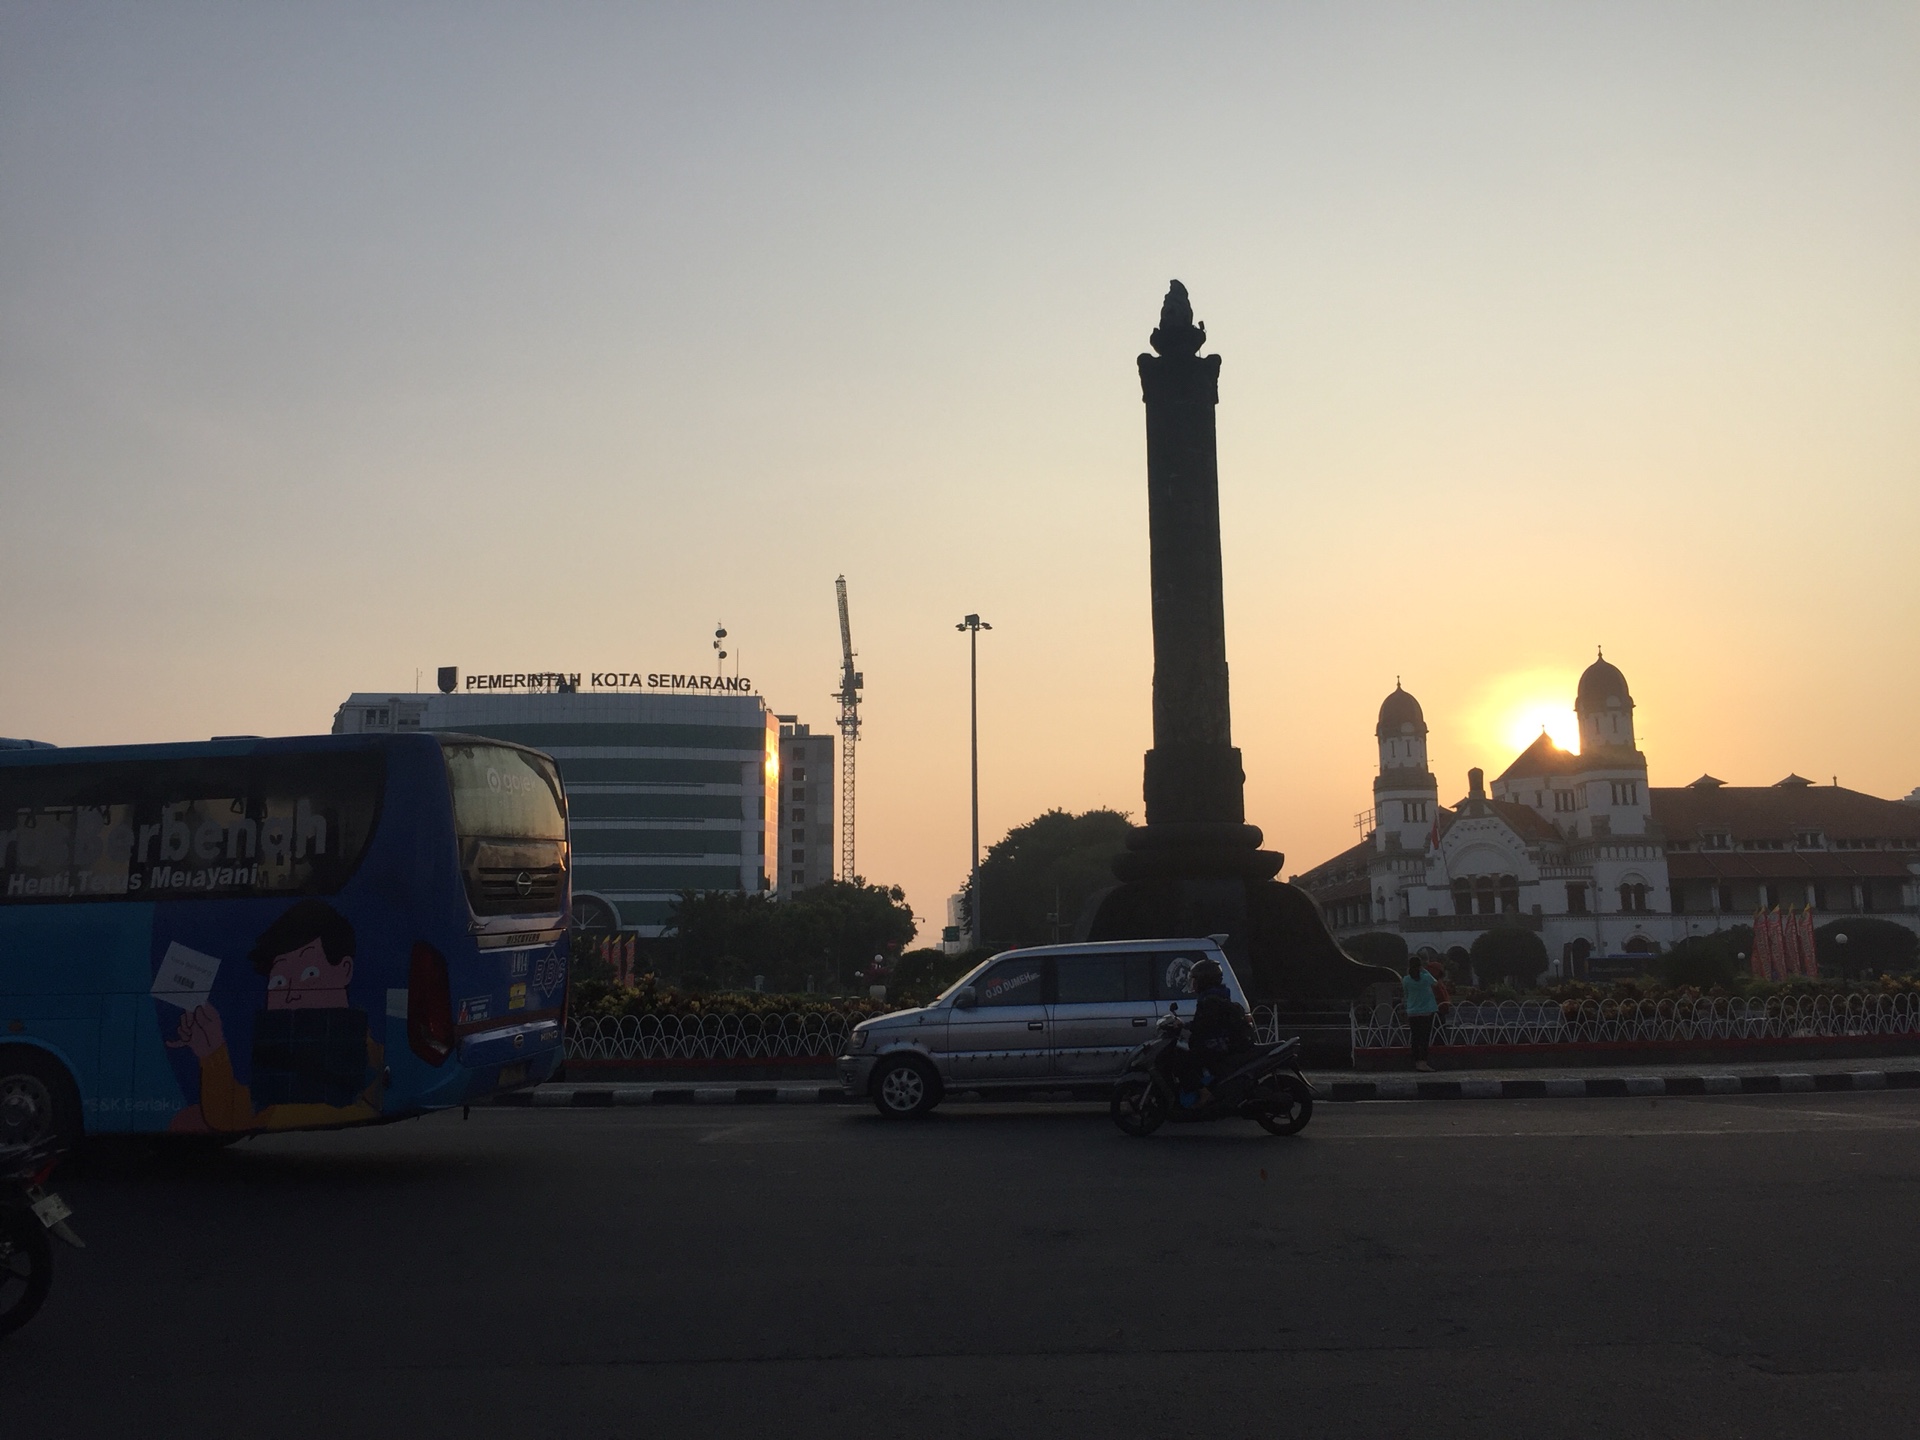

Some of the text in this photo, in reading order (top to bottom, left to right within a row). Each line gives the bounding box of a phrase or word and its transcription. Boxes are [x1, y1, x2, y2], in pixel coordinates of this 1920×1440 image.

[466, 673, 752, 691] PEMERINTAH KOTA SEMARANG
[150, 863, 258, 891] Melayani
[985, 985, 1003, 999] OJO
[1002, 972, 1031, 992] DUMEH
